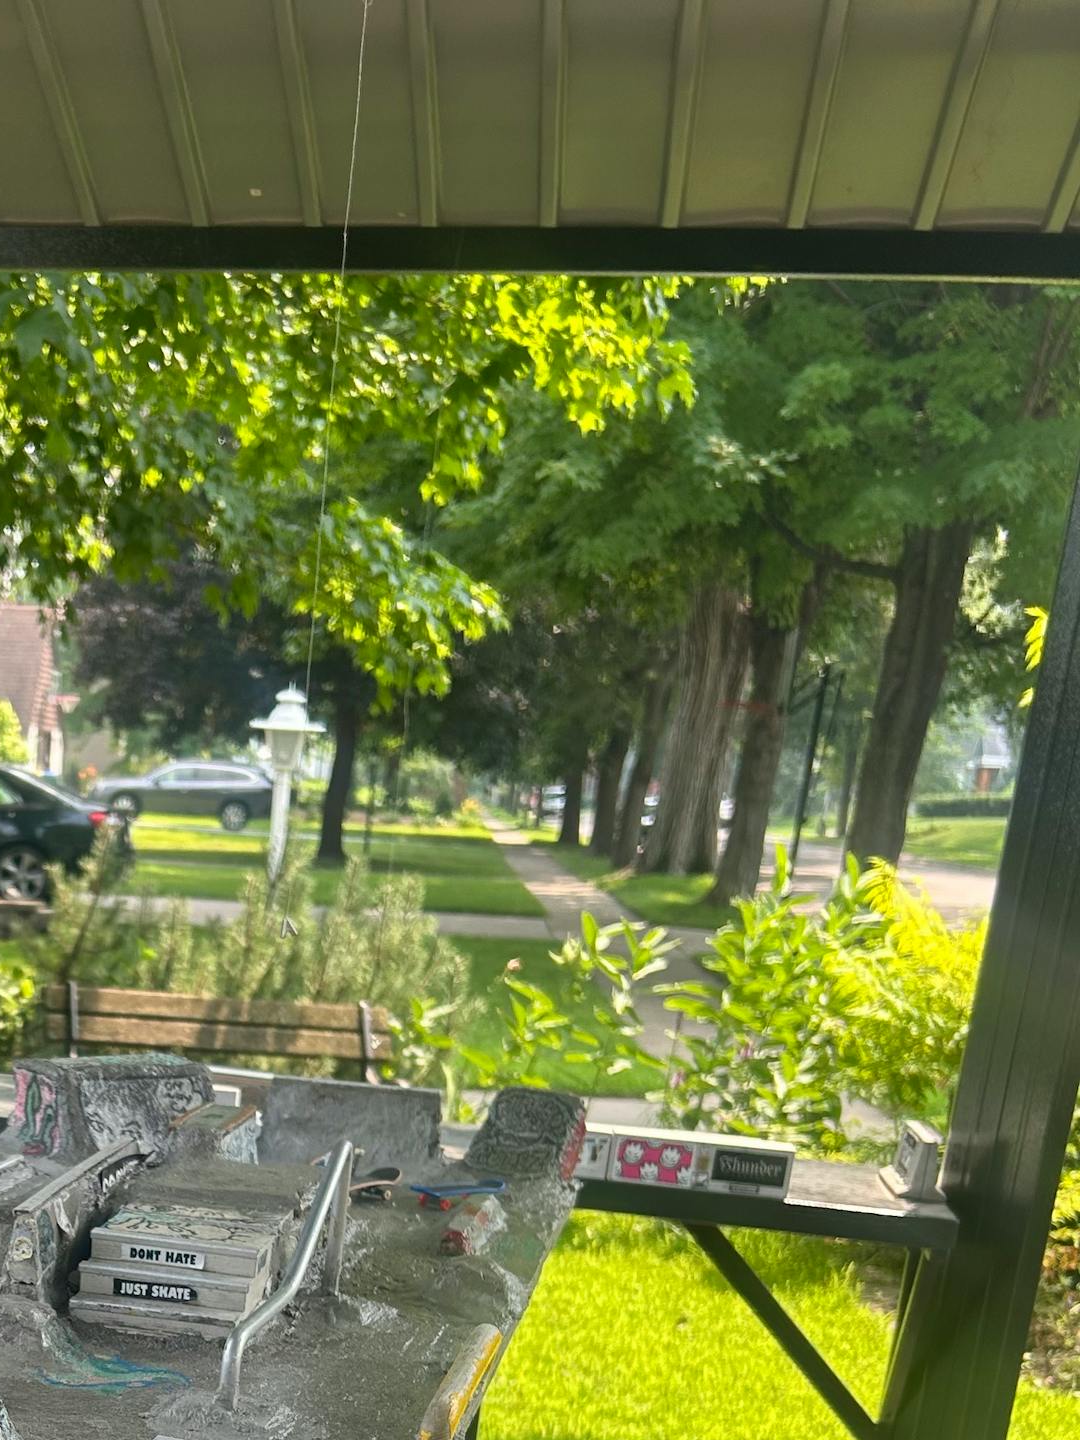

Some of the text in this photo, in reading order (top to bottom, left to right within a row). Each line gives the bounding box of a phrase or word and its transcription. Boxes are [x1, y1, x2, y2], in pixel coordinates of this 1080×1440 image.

[130, 1247, 197, 1265] DONT HATE
[120, 1282, 191, 1301] JUST SKATE
